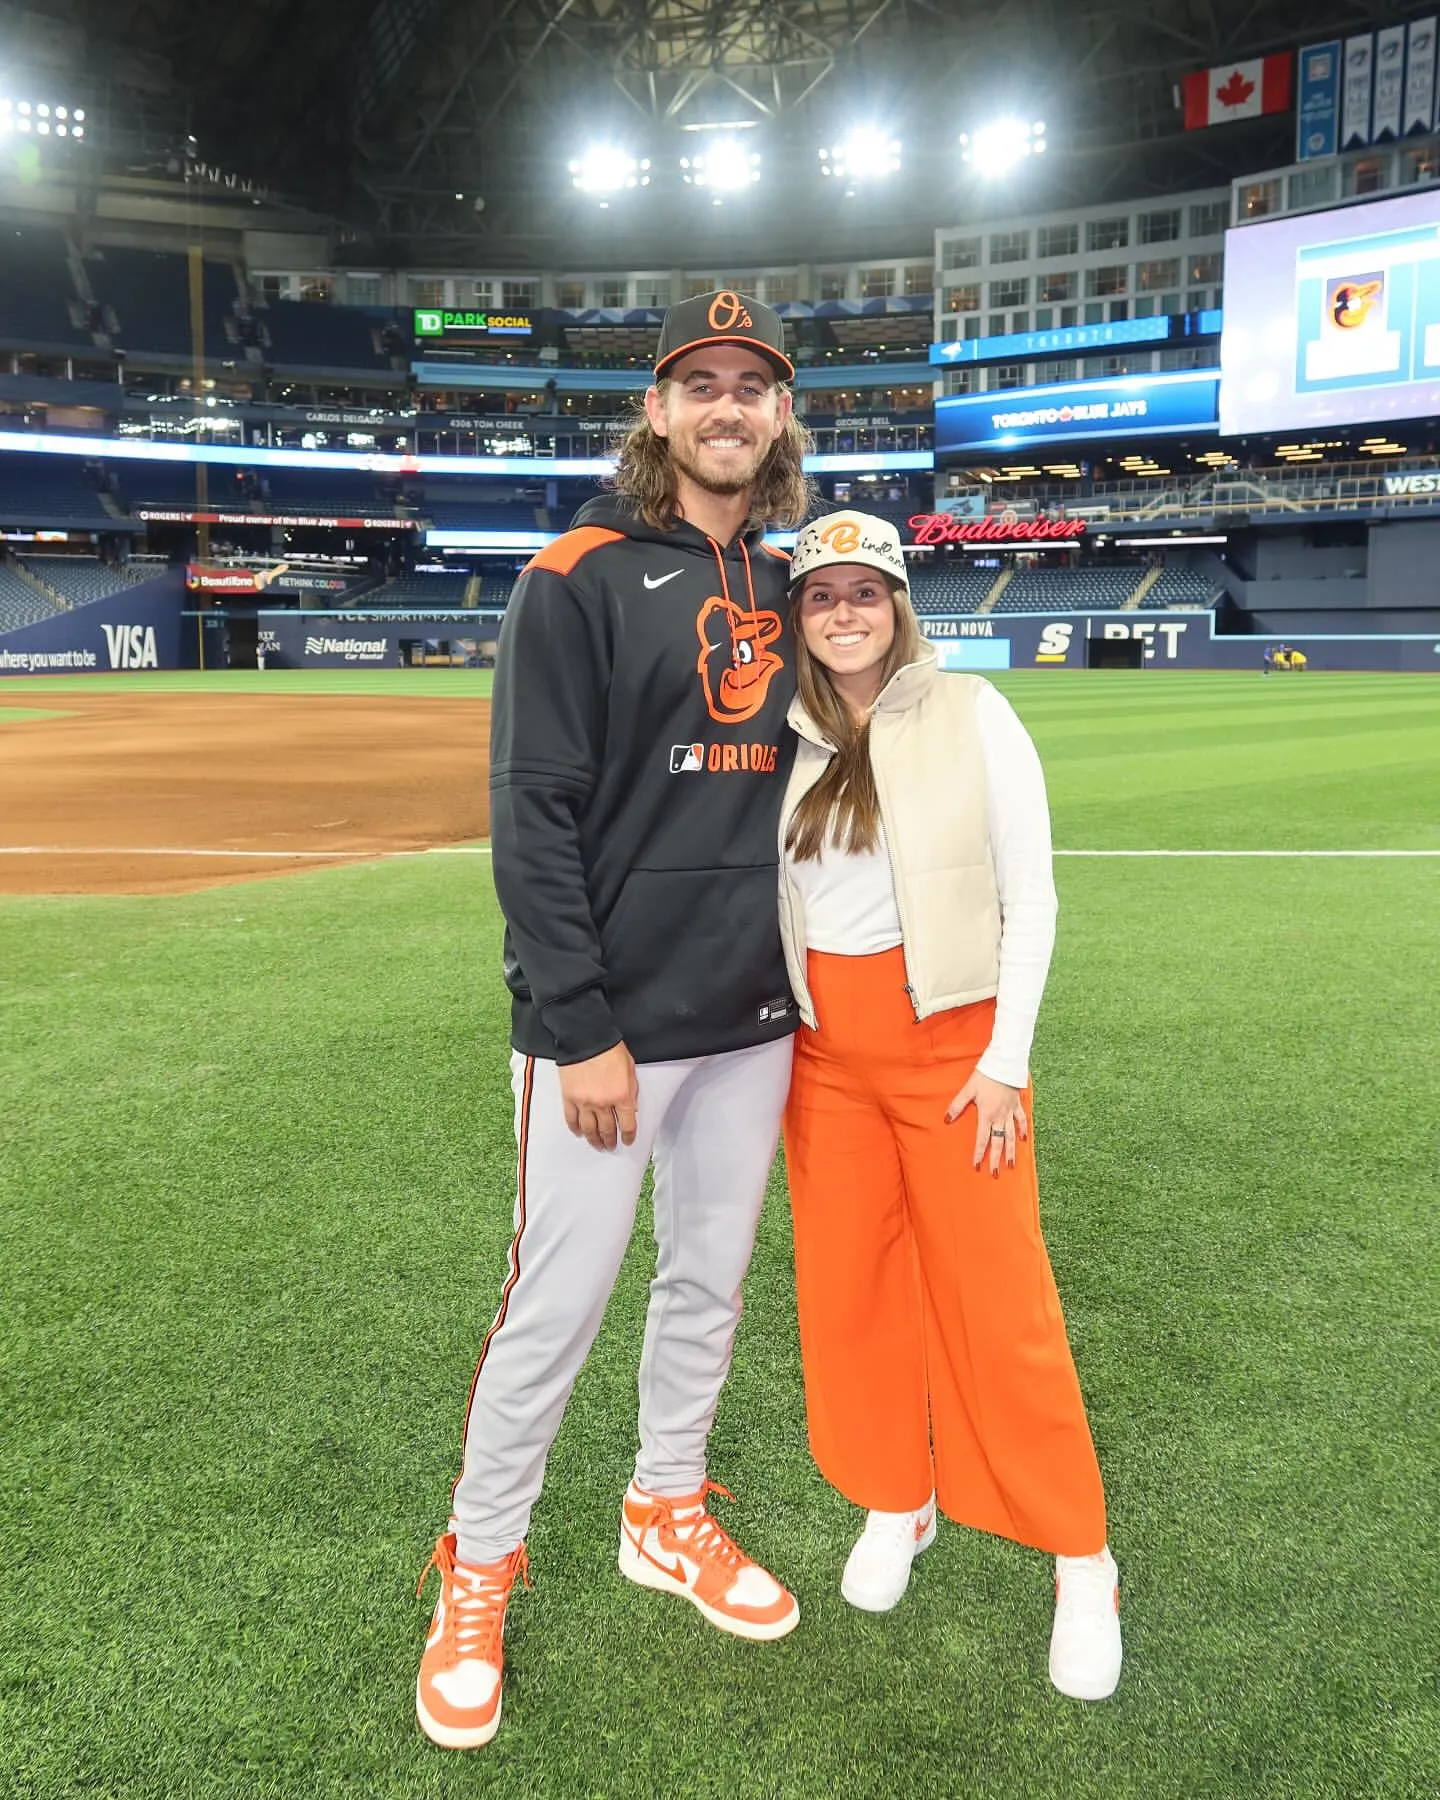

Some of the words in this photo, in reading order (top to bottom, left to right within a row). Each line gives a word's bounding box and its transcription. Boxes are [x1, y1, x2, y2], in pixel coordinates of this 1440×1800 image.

[708, 291, 753, 331] O's
[417, 313, 442, 331] TD
[444, 312, 487, 325] PARK
[487, 316, 532, 327] SOCIAL
[305, 412, 340, 423] CARLOS
[342, 414, 384, 425] DELGADO
[992, 407, 1058, 429] TORONTO
[1110, 399, 1148, 418] JAYS
[473, 419, 495, 429] TOM
[495, 420, 524, 430] CHEEK
[578, 421, 603, 431] TONY
[835, 418, 869, 427] GEORGE
[219, 513, 245, 524] Proud
[282, 516, 298, 526] the
[298, 517, 317, 527] Blue
[318, 518, 338, 529] Jays
[908, 513, 1086, 544] Budweiser
[279, 576, 314, 588] RETHINK
[923, 620, 957, 636] PIZZA
[959, 620, 993, 637] NOVA
[100, 624, 159, 669] VISA
[323, 638, 387, 653] National
[28, 652, 48, 672] you
[48, 650, 73, 668] want
[73, 650, 83, 667] to
[83, 648, 97, 667] be
